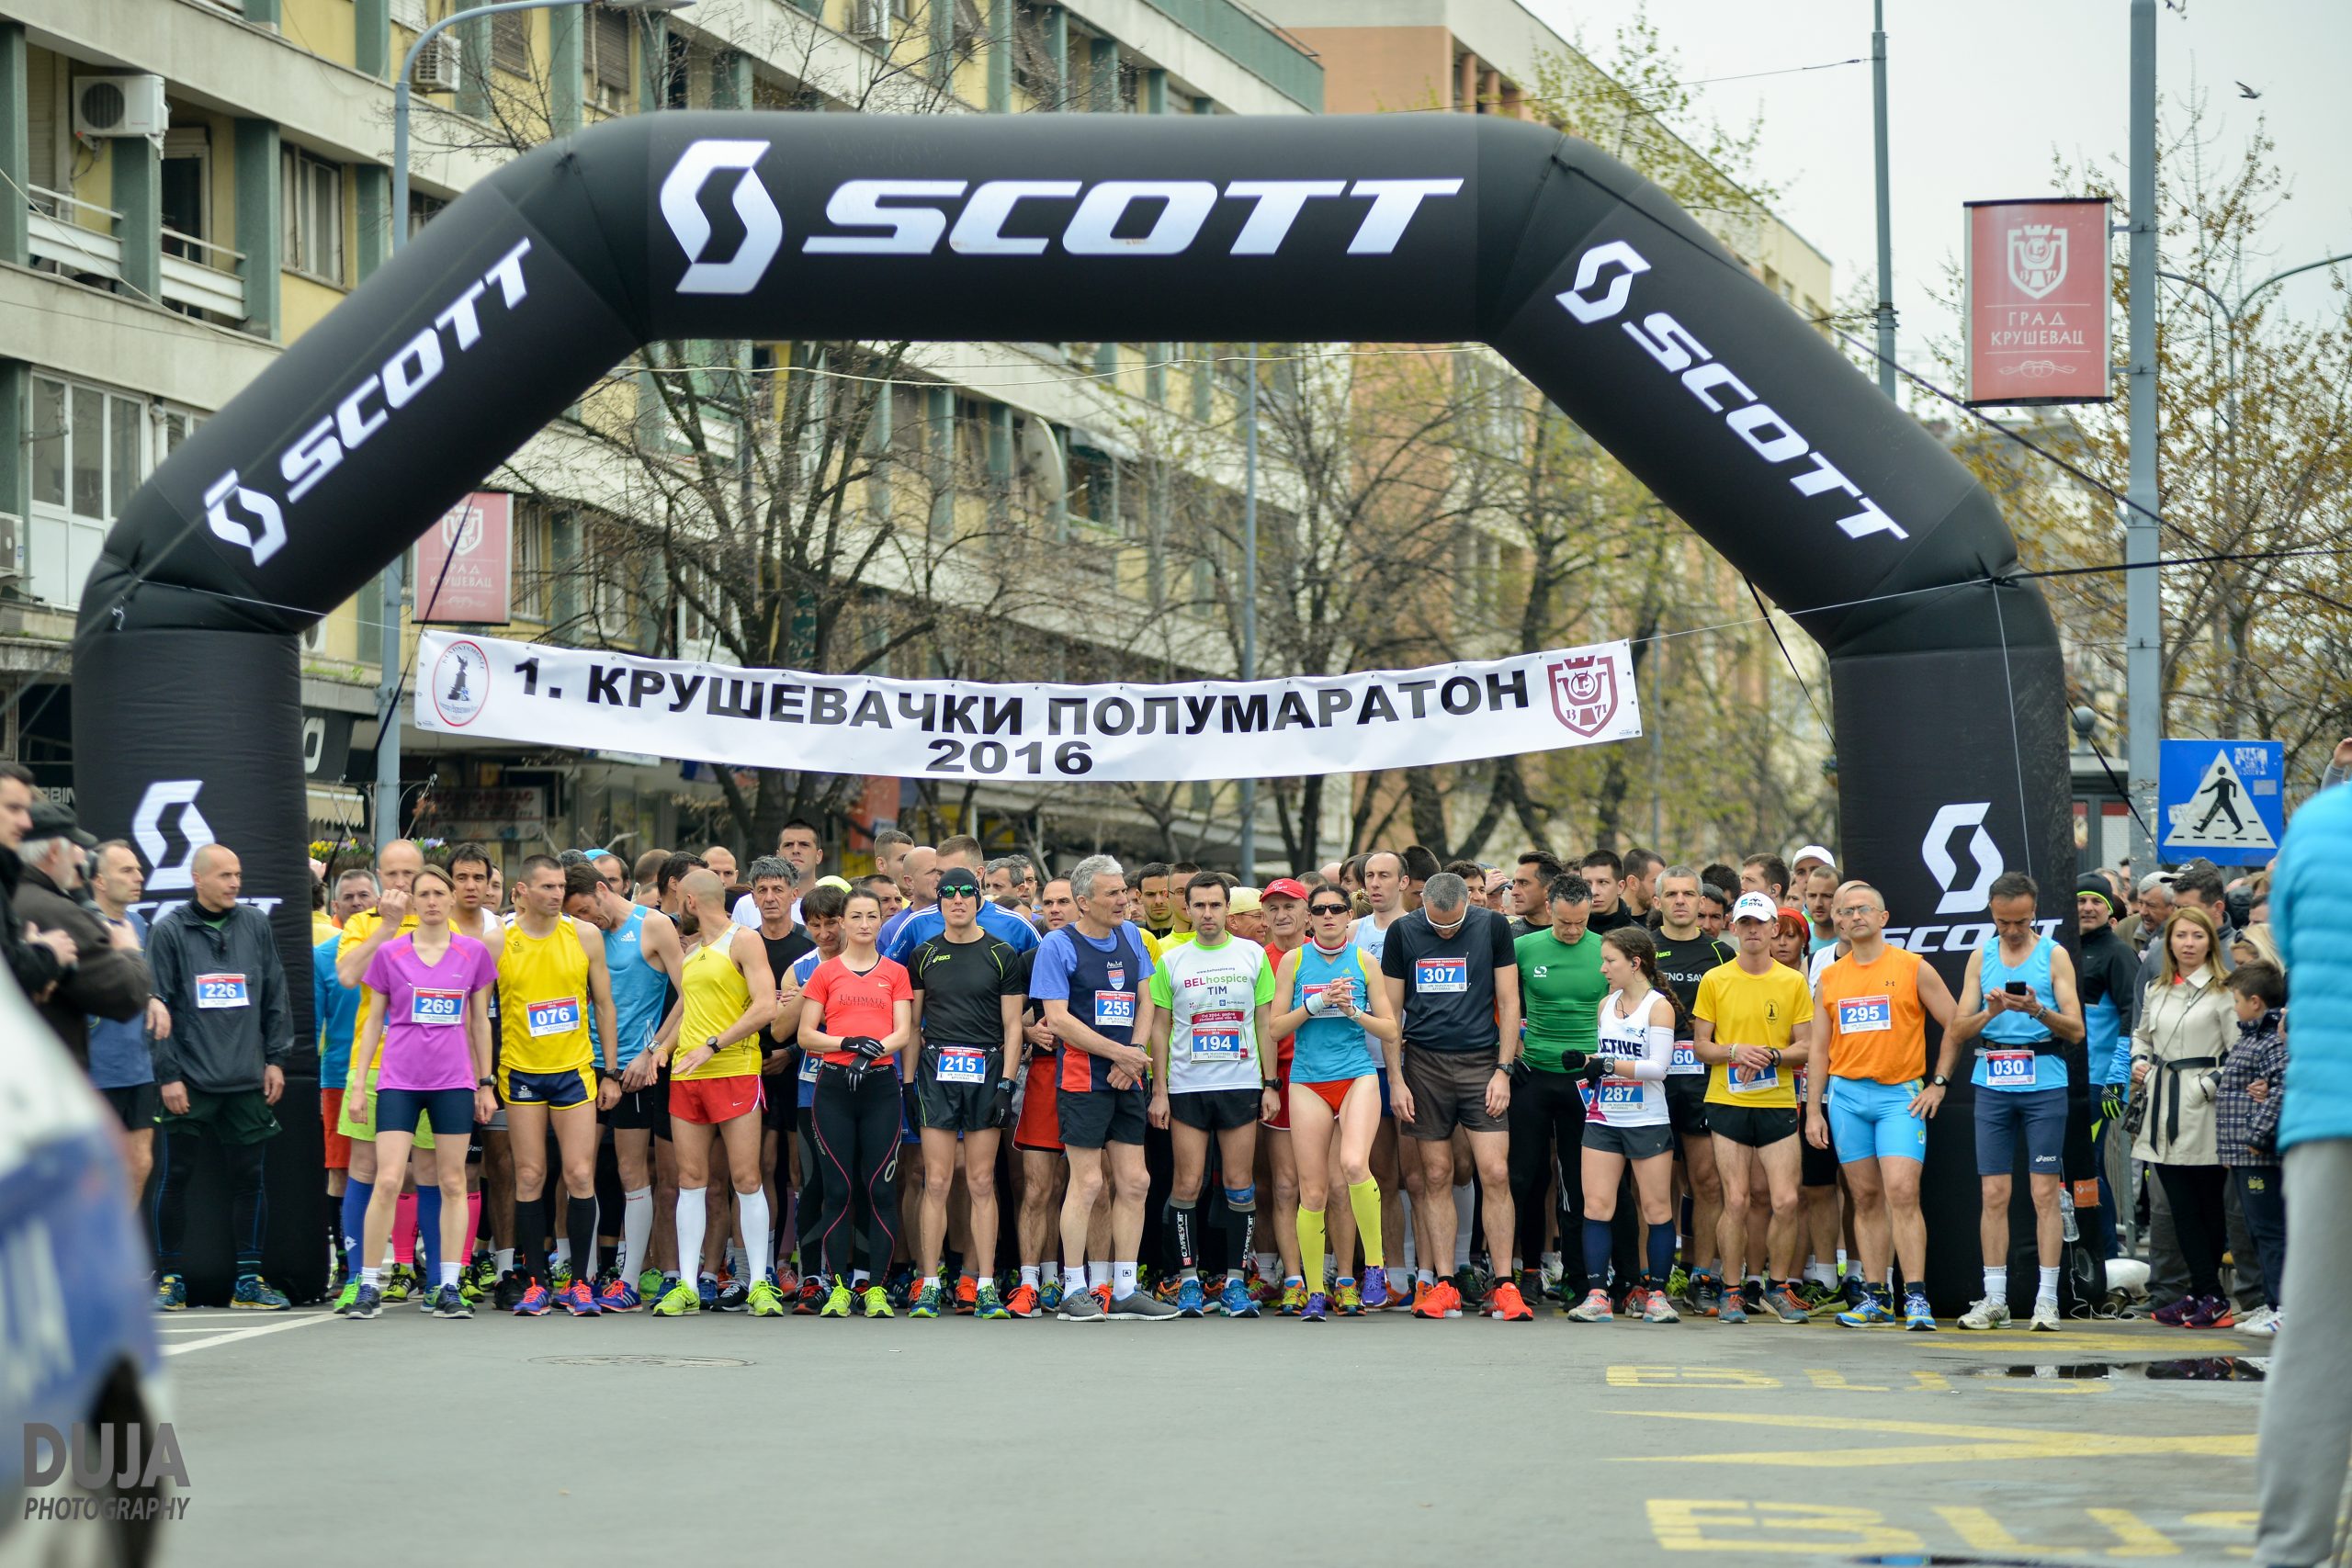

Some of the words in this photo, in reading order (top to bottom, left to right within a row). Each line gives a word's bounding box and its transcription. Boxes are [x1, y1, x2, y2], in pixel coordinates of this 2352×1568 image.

[802, 178, 1465, 254] SCOTT
[2008, 311, 2066, 326] ГРАД
[1991, 330, 2085, 345] КРУШЕВАЦ
[279, 236, 532, 504] SCOTT
[1622, 311, 1910, 540] SCOTT
[429, 575, 492, 588] КУШЕВАЦ
[514, 657, 562, 699] 1.
[586, 664, 1023, 736] КРУШЕВАЧКИ
[1048, 670, 1529, 736] ПОЛУМАРАТОН
[925, 739, 1093, 775] 2016
[1883, 919, 2064, 953] SCOT
[1183, 974, 1248, 988] BELhospice
[1424, 967, 1456, 983] 307
[205, 983, 237, 998] 226
[1207, 986, 1227, 995] TIM
[420, 998, 455, 1014] 269
[1103, 1000, 1130, 1016] 255
[1847, 1005, 1880, 1022] 295
[536, 1007, 571, 1025] 076
[1199, 1035, 1232, 1051] 194
[944, 1056, 977, 1073] 215
[1993, 1059, 2025, 1076] 030
[1604, 1087, 1634, 1101] 287
